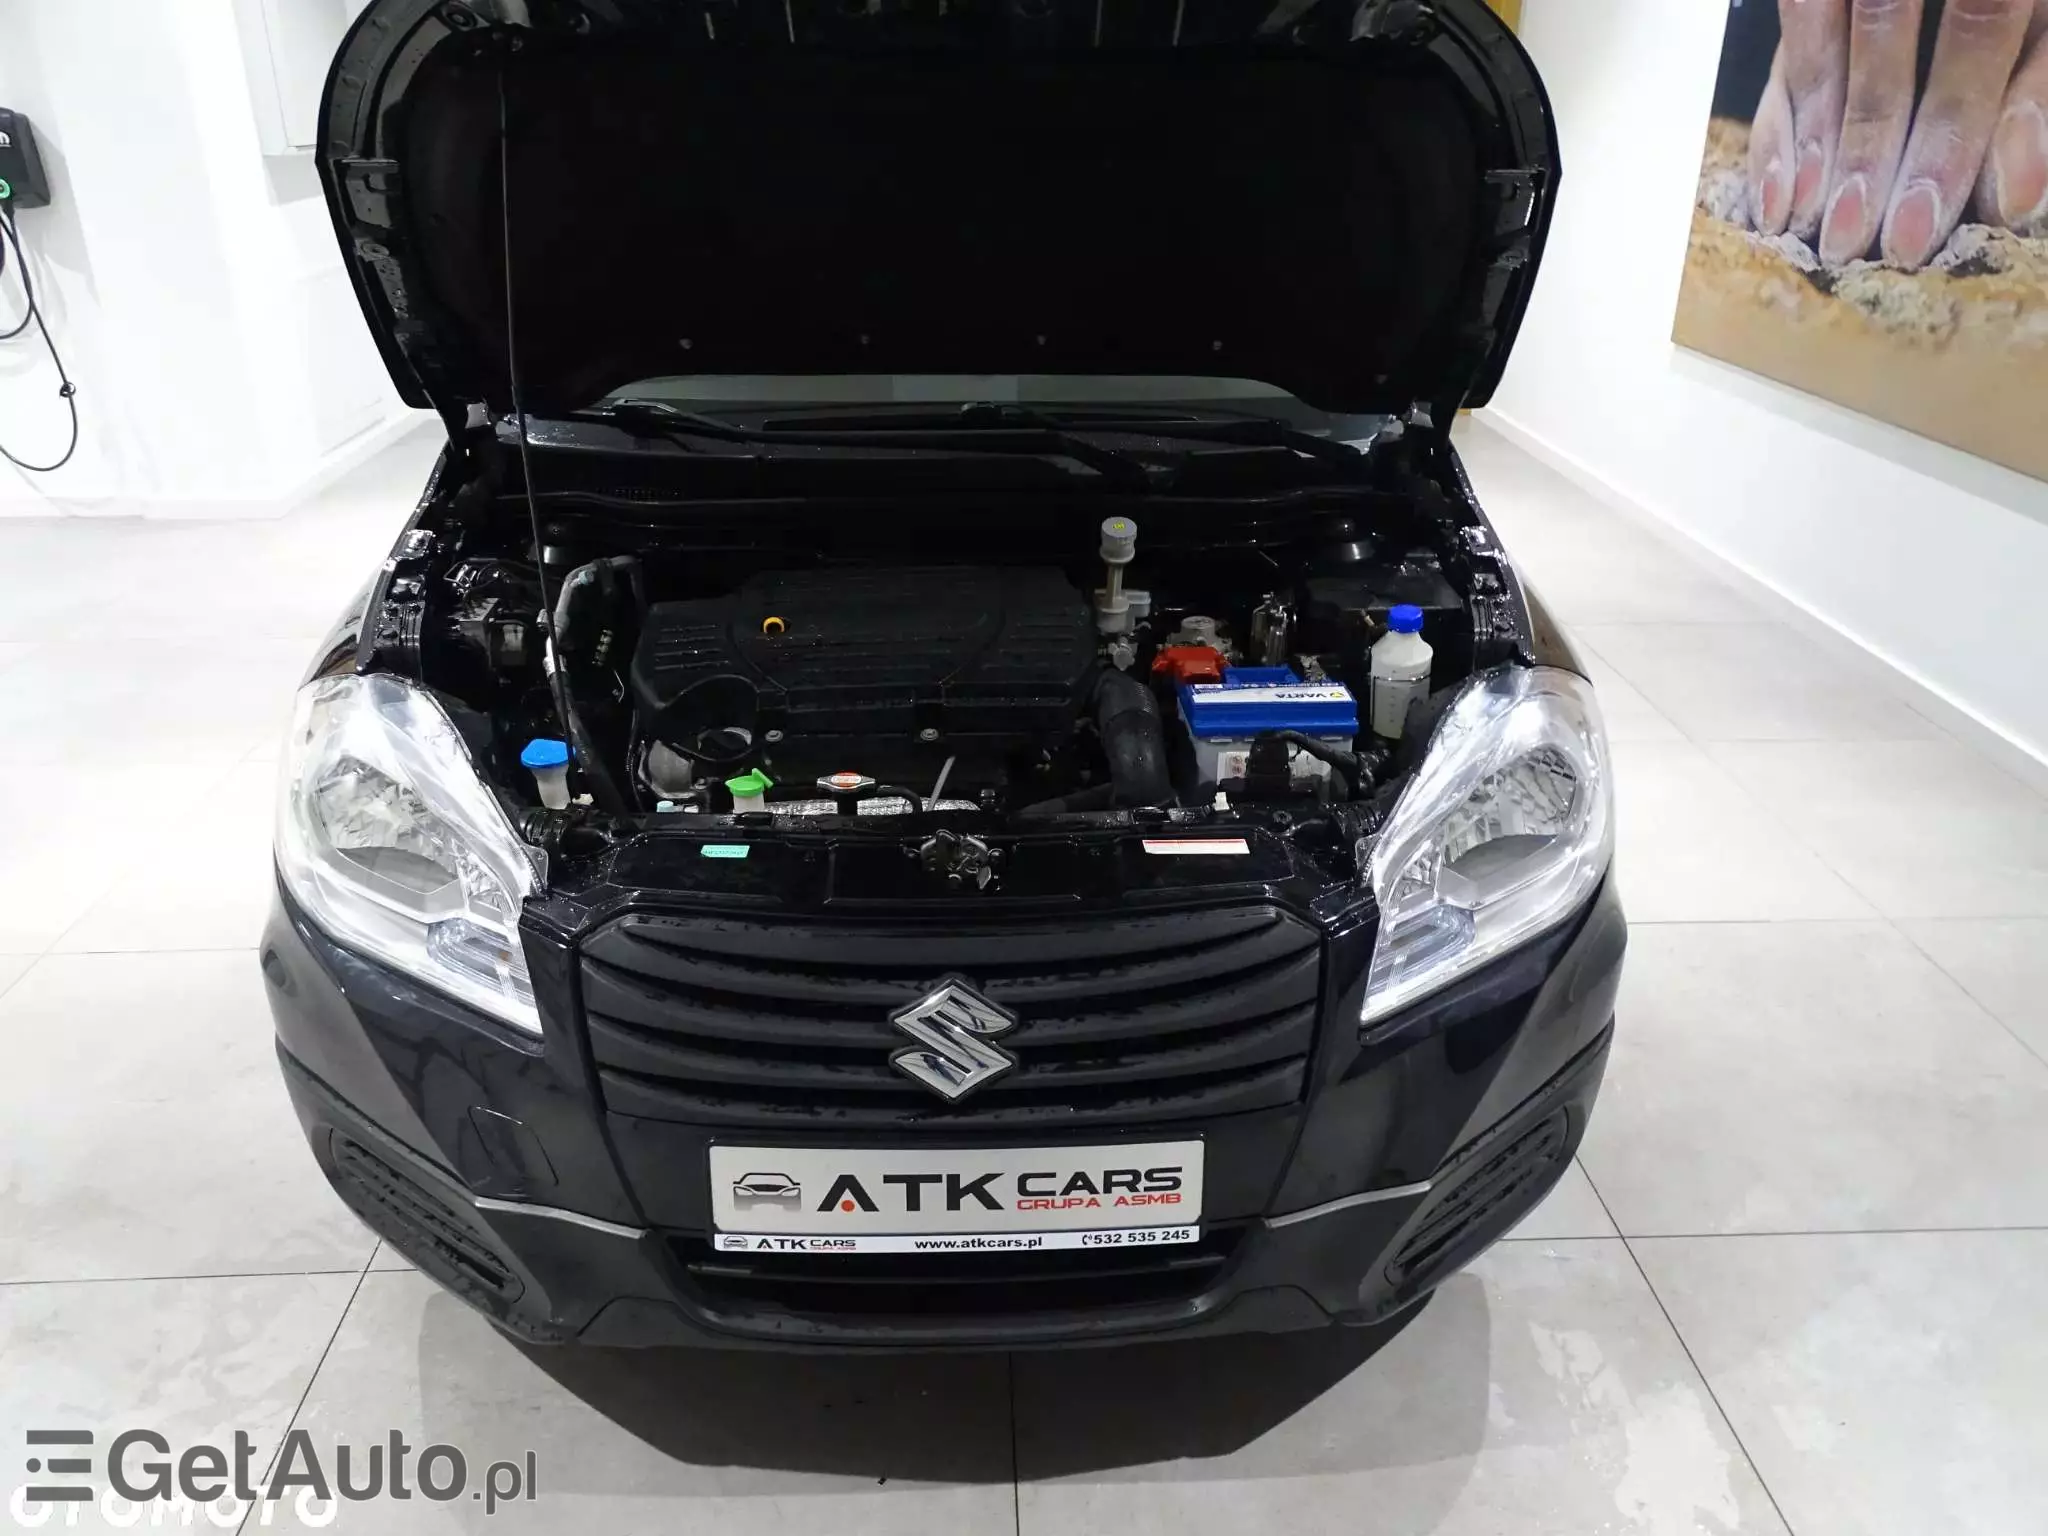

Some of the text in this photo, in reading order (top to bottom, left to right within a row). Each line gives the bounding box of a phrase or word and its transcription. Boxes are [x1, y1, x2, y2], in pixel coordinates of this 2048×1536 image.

[816, 1166, 1183, 1212] ATK CARS
[1016, 1192, 1182, 1210] GRUPA ASMB
[756, 1238, 856, 1250] ATK CARS
[915, 1237, 1043, 1249] www.atkcars.pl
[1093, 1230, 1190, 1244] 532 535 245
